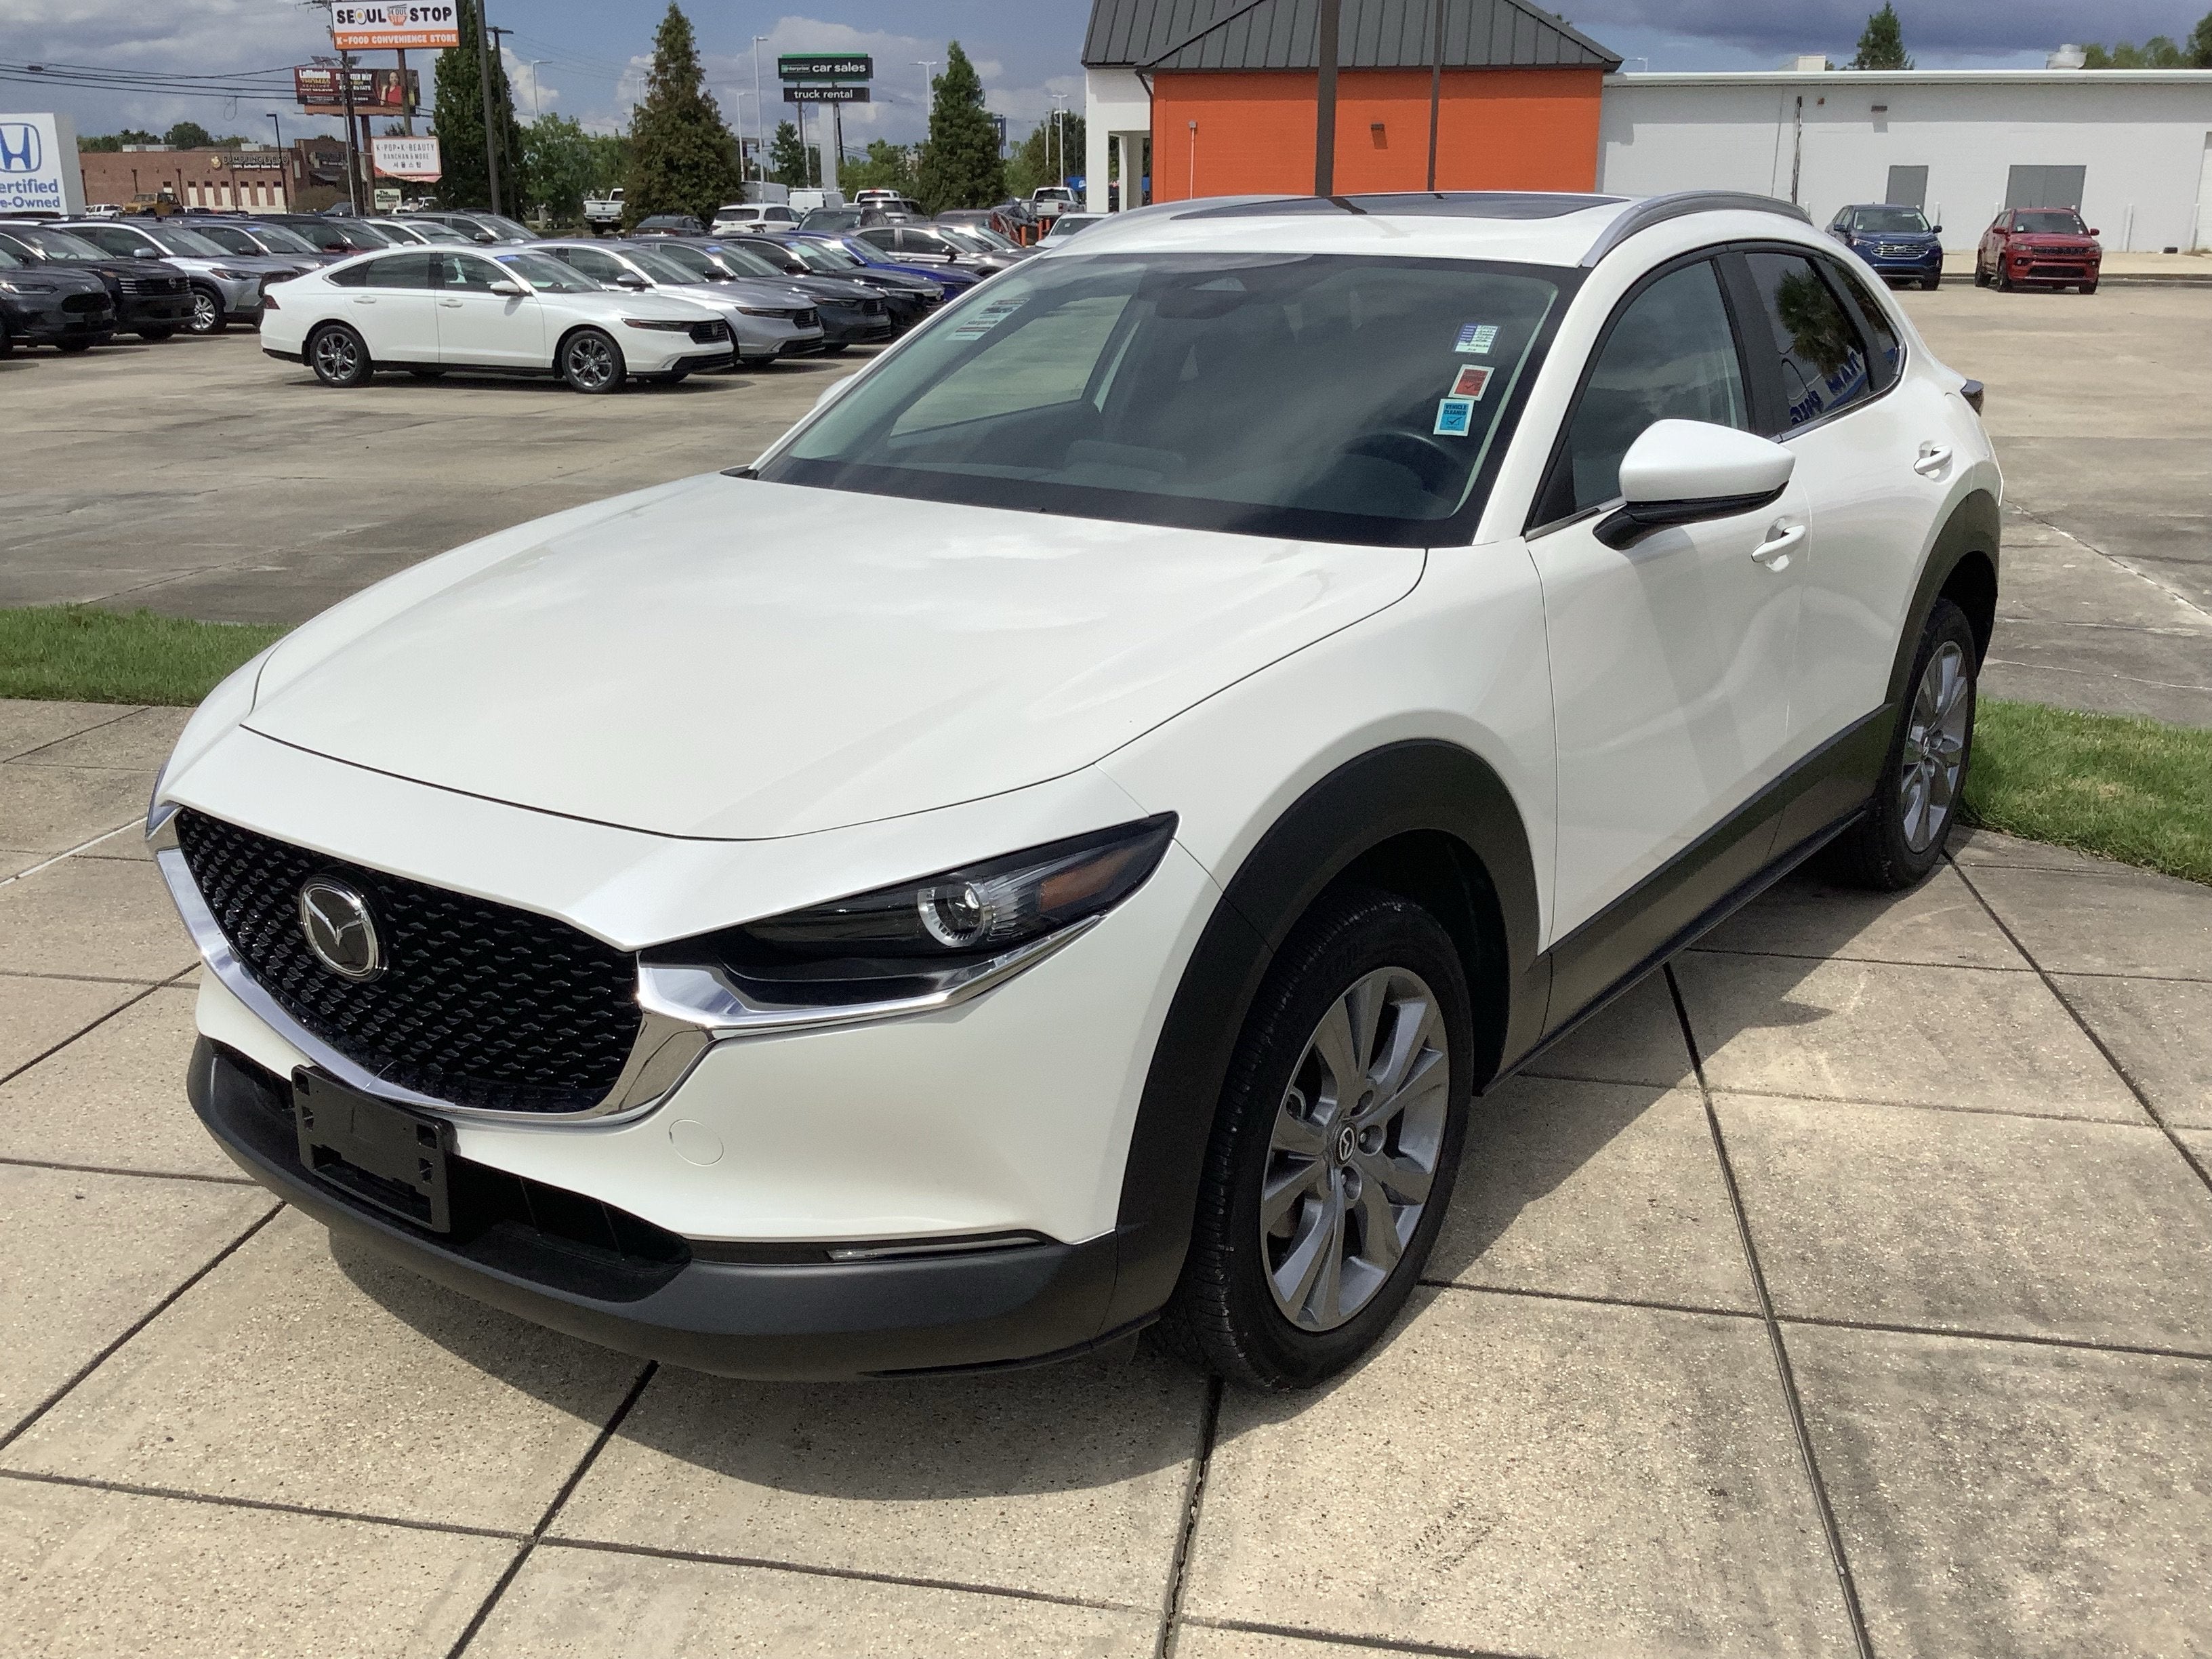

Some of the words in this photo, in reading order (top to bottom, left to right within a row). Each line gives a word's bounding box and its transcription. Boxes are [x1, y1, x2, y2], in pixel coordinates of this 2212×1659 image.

[337, 8, 387, 24] SEOUL
[410, 7, 452, 22] STOP
[336, 36, 369, 45] K-FOOD
[371, 35, 427, 44] CONVENIENCE
[430, 34, 457, 43] STORE
[812, 64, 832, 73] car
[834, 62, 866, 73] sales
[794, 89, 820, 98] truck
[823, 89, 853, 98] rental
[0, 178, 58, 193] ertified
[0, 196, 60, 208] e-Owned
